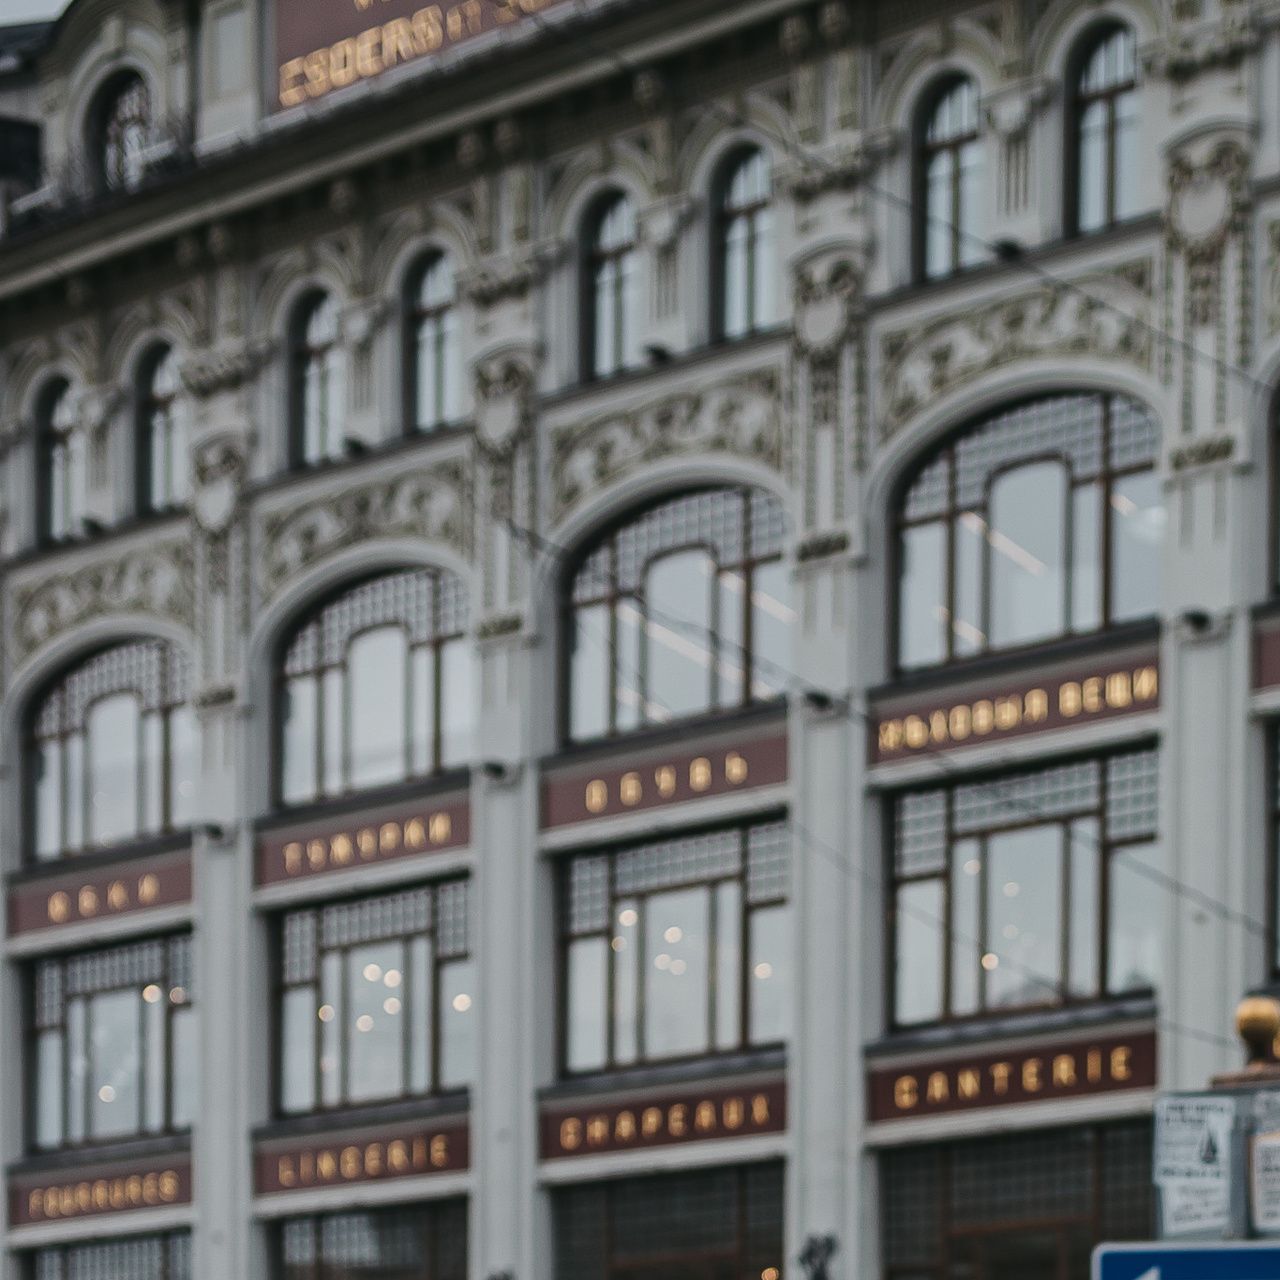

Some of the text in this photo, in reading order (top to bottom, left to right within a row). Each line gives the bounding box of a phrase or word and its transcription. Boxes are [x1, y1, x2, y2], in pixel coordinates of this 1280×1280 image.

[1058, 665, 1158, 718] ВЕЩИ
[560, 1092, 770, 1151] CHAPEAUX
[278, 1132, 449, 1187] LINGERIE
